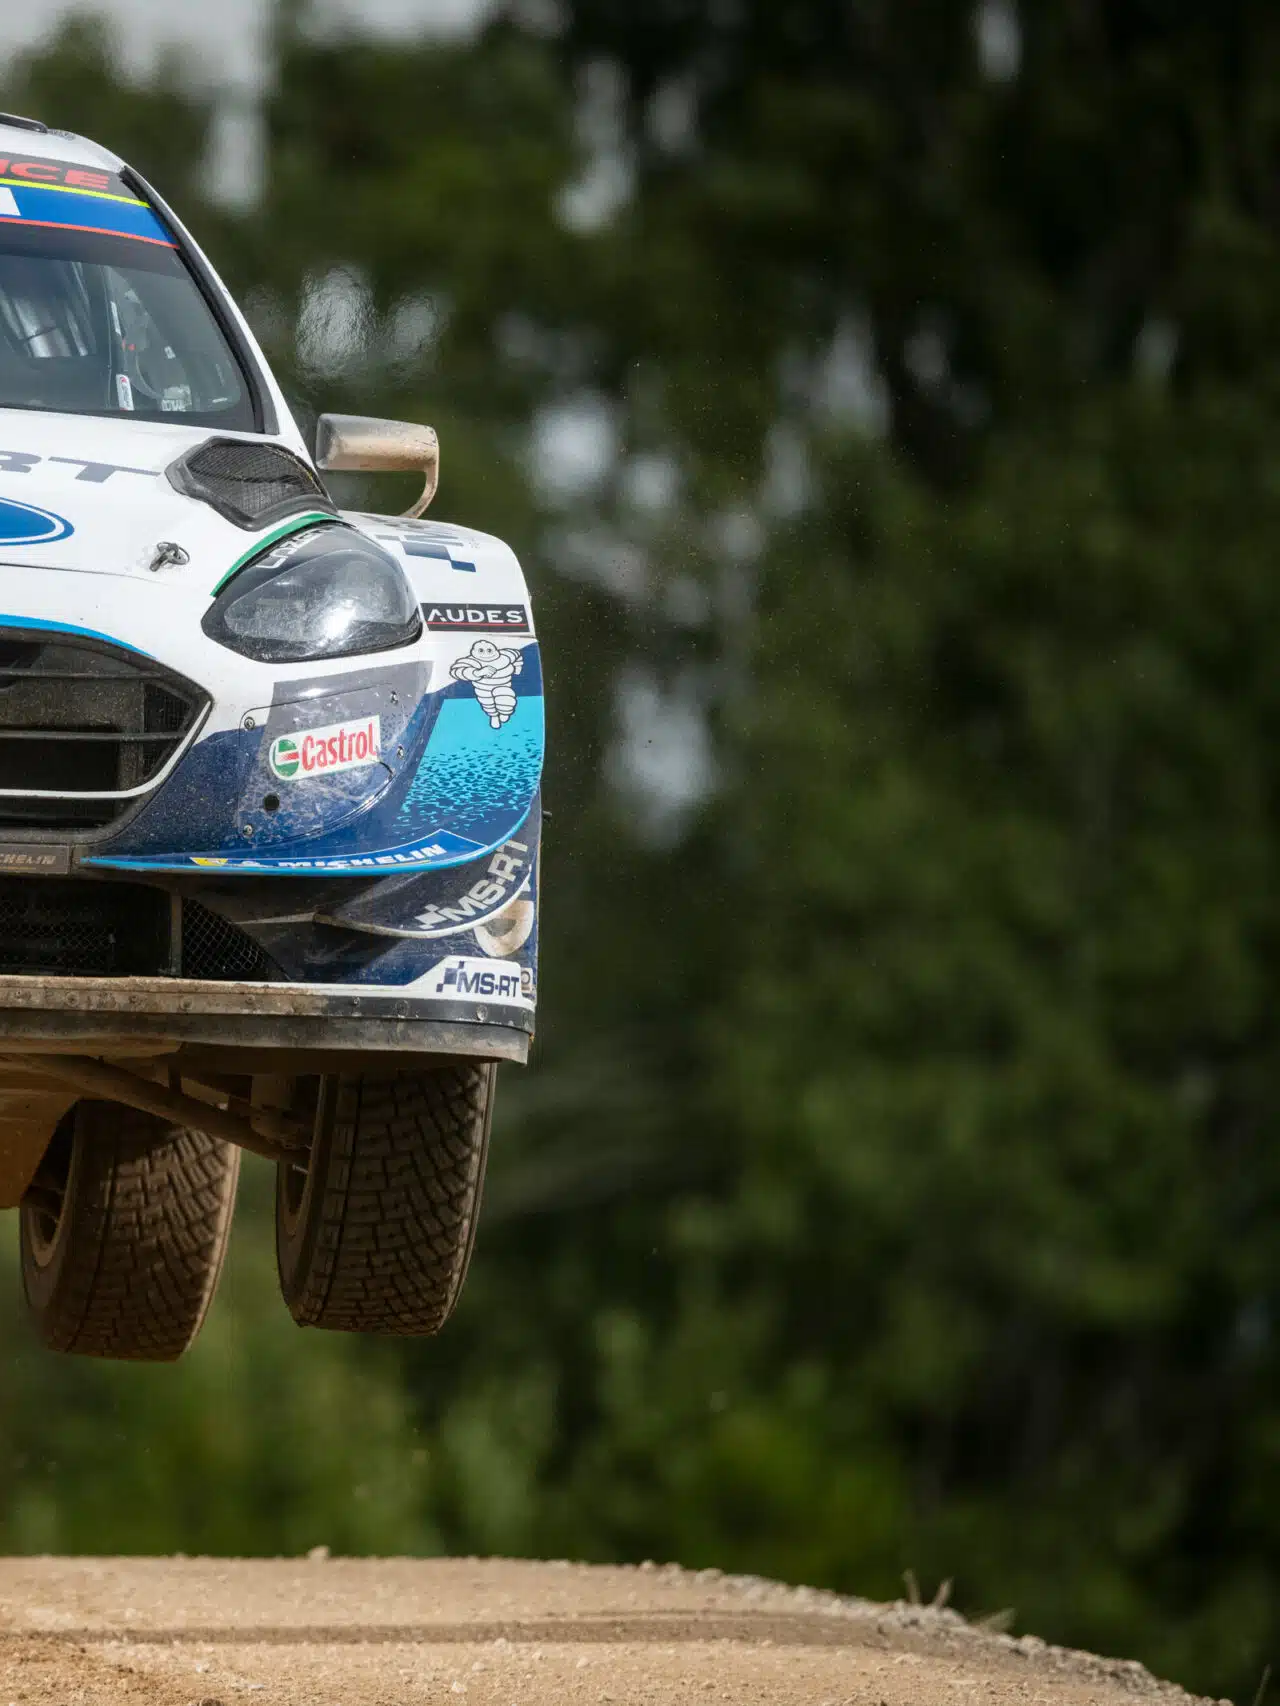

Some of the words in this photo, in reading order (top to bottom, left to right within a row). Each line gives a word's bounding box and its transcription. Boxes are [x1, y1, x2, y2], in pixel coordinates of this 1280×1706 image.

[426, 609, 524, 625] AUDES
[301, 721, 378, 769] Castrol
[456, 972, 520, 998] MS-RT
